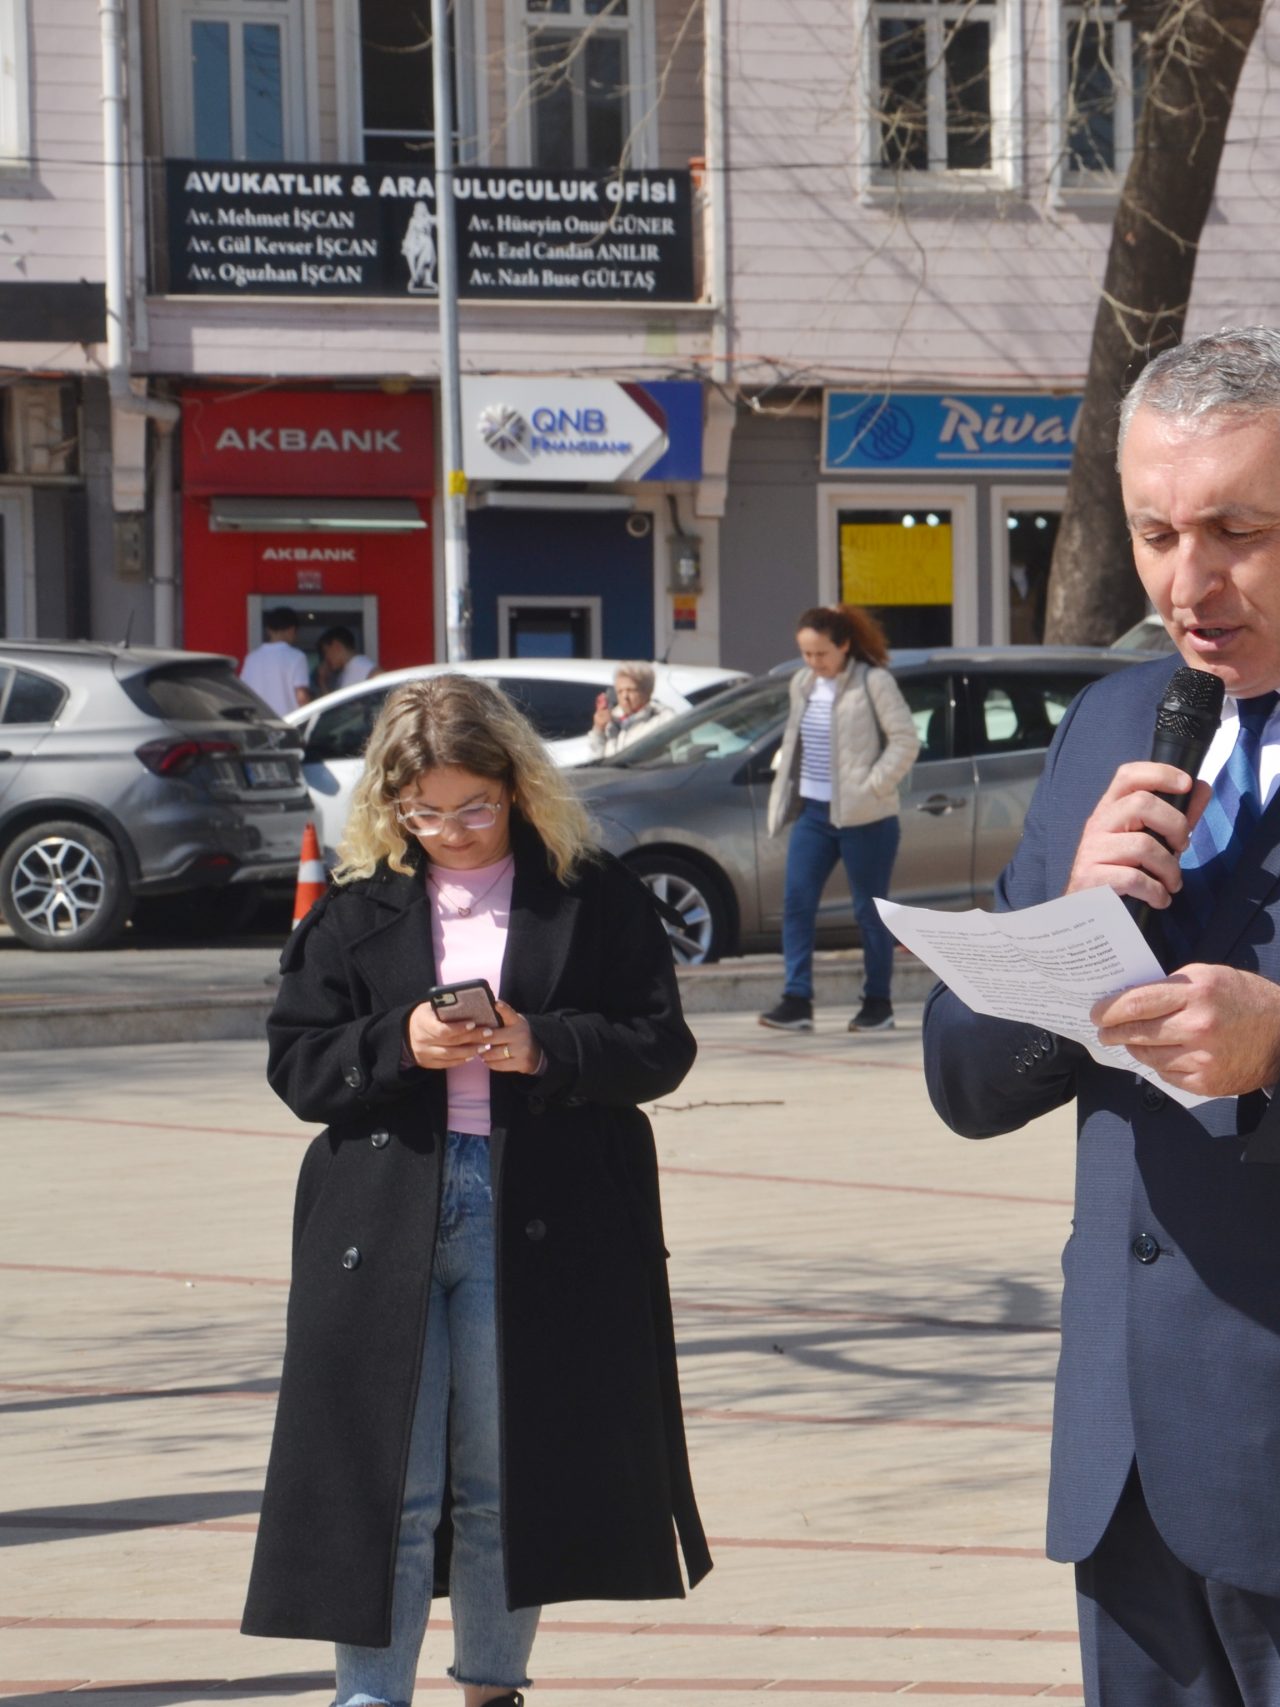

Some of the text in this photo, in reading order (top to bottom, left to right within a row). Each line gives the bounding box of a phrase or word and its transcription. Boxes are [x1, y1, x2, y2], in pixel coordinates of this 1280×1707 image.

[185, 171, 676, 203] AVUKATLIK & ARAULUCULUK OFİSİ
[186, 206, 355, 231] Av. Mehmet İŞCAN
[468, 213, 676, 237] Av. Hüseyin Onur GÜNER
[187, 236, 215, 254] Av.
[218, 235, 251, 255] Gül
[254, 237, 314, 255] Kevser
[469, 241, 496, 259] Av.
[498, 241, 531, 260] Ezel
[188, 263, 215, 281] Av.
[219, 262, 299, 288] Oğuzhan
[470, 268, 496, 286] Av.
[542, 269, 581, 288] Buse
[582, 267, 656, 292] GÜLTAŞ
[532, 407, 606, 433] QNB
[215, 427, 402, 453] AKBANK
[262, 547, 357, 563] AKBANK
